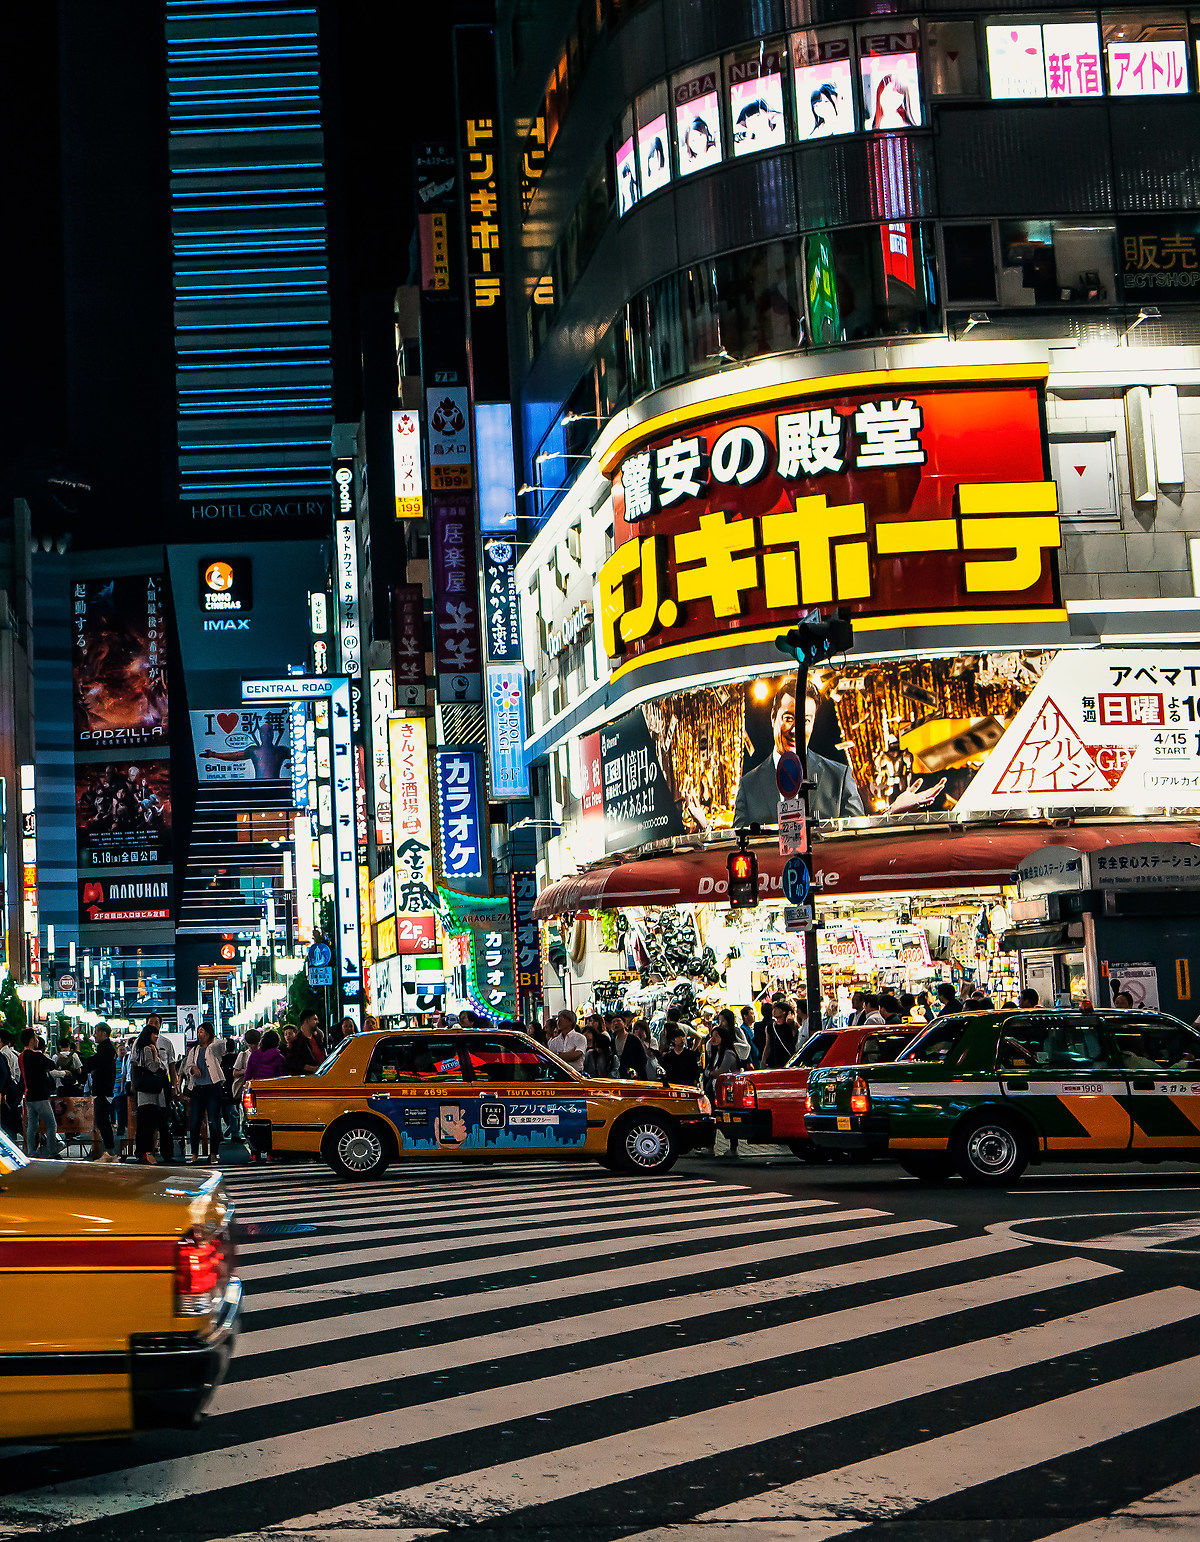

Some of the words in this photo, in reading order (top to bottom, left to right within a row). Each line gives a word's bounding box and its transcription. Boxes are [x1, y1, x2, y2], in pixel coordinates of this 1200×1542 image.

[1049, 53, 1099, 94] 新宿
[1114, 51, 1183, 90] アイドル
[1124, 236, 1198, 270] 販売
[620, 400, 926, 521] 驚安の殿堂
[191, 503, 246, 521] HOTEL
[341, 524, 353, 579] ネットカフェ
[204, 592, 232, 603] TOHO
[204, 600, 242, 611] CINEMAS
[75, 584, 87, 655] 起動する。
[203, 619, 250, 631] IMAX
[246, 683, 298, 694] CENTRAL
[302, 681, 333, 692] ROAD
[1082, 696, 1097, 723] 毎週
[1103, 695, 1161, 723] 日曜
[1168, 697, 1181, 722] よる
[80, 727, 163, 740] GODZILLA
[499, 712, 510, 755] STAGE
[508, 712, 519, 748] IDOL
[1154, 733, 1187, 745] 4/15
[1097, 750, 1132, 770] GP
[1154, 746, 1188, 756] START
[401, 724, 419, 814] きんくら酒場
[501, 768, 520, 781] 5F
[445, 758, 477, 873] カラオケ
[336, 744, 354, 934] ゴジラロード
[397, 838, 438, 913] 金の蔵
[787, 869, 798, 899] P
[110, 882, 168, 899] MARUHAN
[400, 920, 423, 938] 2F
[517, 877, 538, 968] カラオケ
[485, 931, 507, 1006] カラオケ
[520, 972, 539, 986] B1
[423, 1088, 449, 1097] 4695
[530, 1088, 557, 1097] KOTSU
[588, 1088, 623, 1098] TAXI
[1079, 1083, 1104, 1094] 1908
[483, 1107, 502, 1115] TAXI
[509, 1104, 584, 1115] アプリで呼べる。
